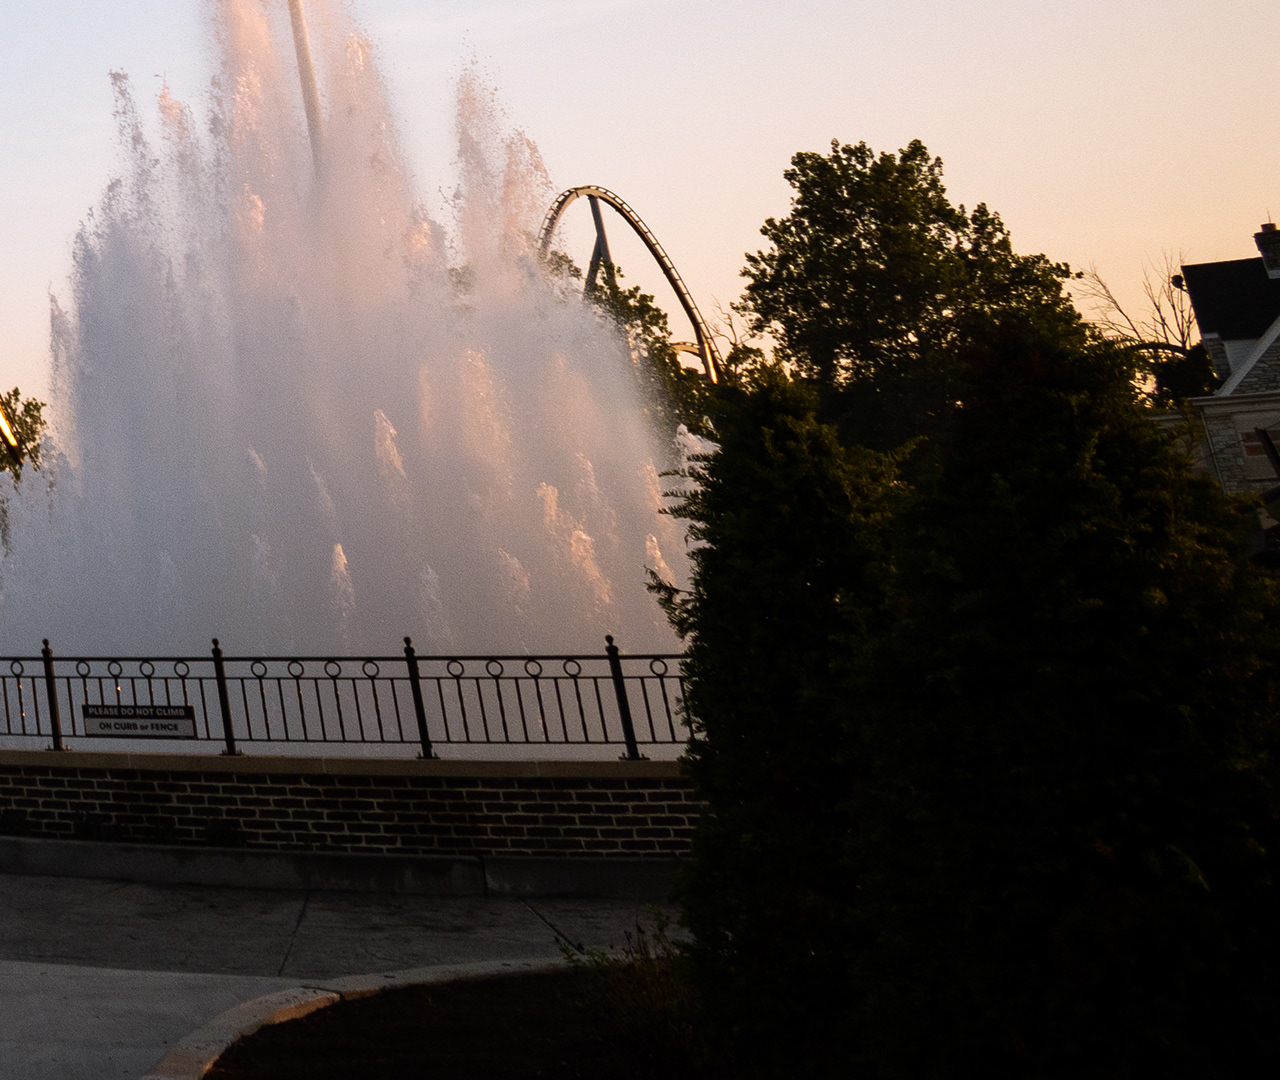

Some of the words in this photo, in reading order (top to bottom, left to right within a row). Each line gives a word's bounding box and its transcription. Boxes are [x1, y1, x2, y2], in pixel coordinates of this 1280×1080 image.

[88, 707, 119, 716] PLEASE
[121, 707, 134, 716] DO
[136, 707, 154, 716] NOT
[156, 707, 185, 717] CLIMB
[99, 722, 112, 730] ON
[151, 723, 179, 731] FENCE
